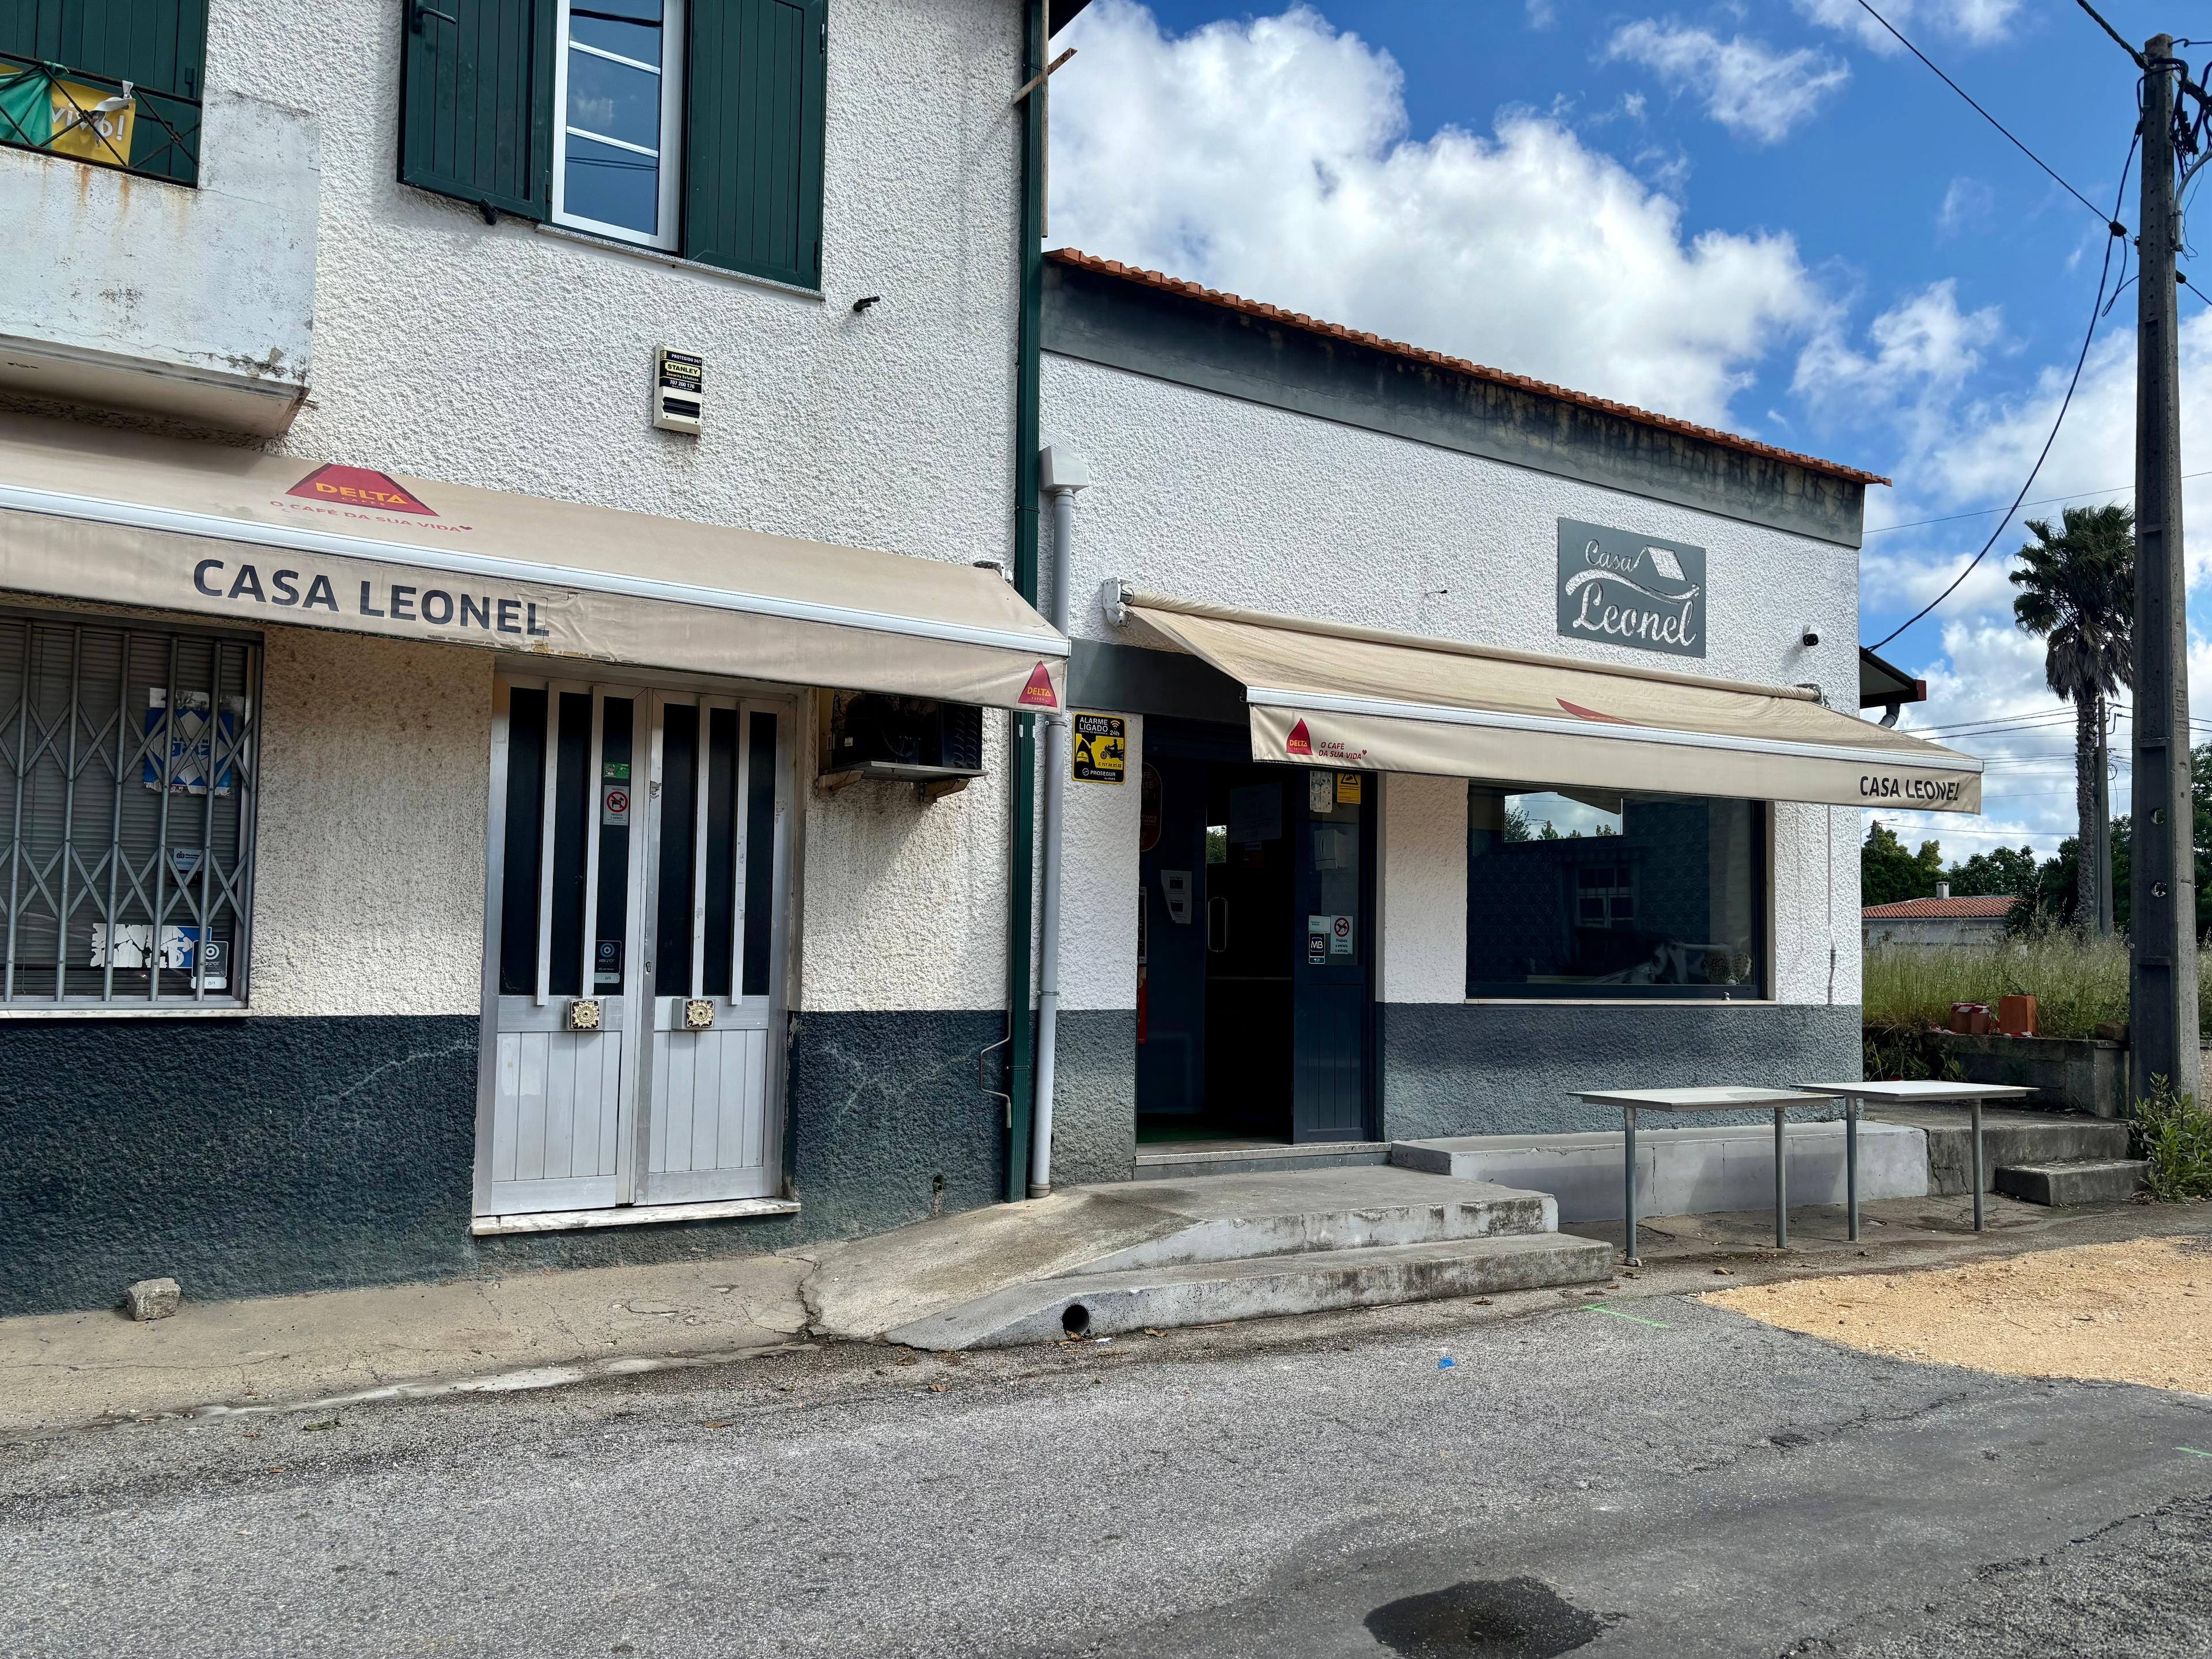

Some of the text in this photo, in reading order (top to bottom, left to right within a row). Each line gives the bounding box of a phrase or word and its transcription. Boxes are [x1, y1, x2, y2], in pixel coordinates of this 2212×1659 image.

[671, 354, 694, 362] PROTEGIDO
[668, 364, 698, 374] STANLEY
[316, 482, 408, 505] DELTA
[290, 503, 338, 516] CAFÉ
[375, 516, 412, 525] SUA
[417, 522, 461, 532] VIDA
[1585, 539, 1637, 572] Casa
[194, 559, 549, 637] CASA LEONEL
[1573, 582, 1698, 646] Leonel
[1027, 687, 1051, 697] DELTA
[1080, 717, 1108, 726] ALARME
[1079, 723, 1108, 733] LIGADO
[1328, 742, 1345, 750] CAFÉ
[1860, 776, 1960, 801] CASA LEONEL
[1310, 941, 1323, 949] MB
